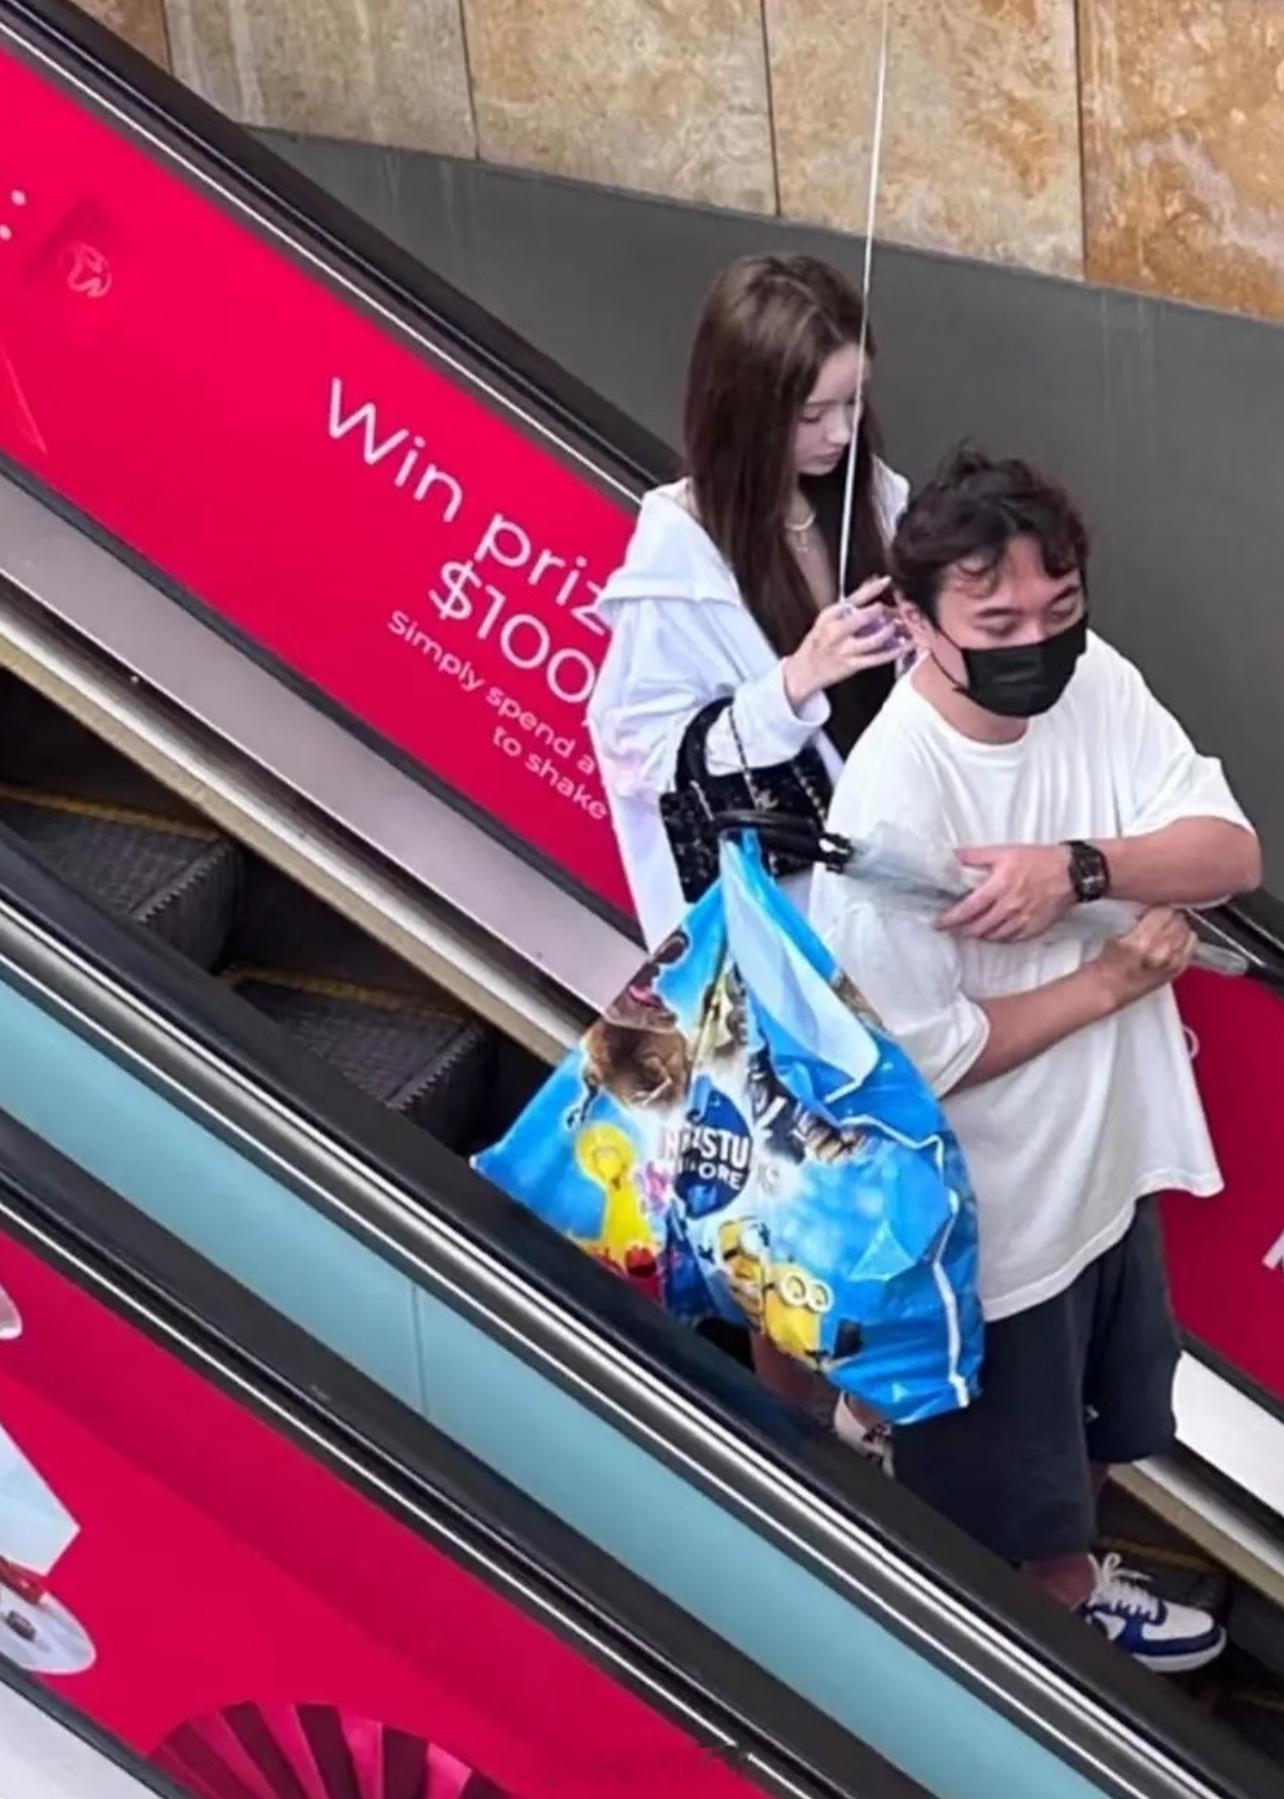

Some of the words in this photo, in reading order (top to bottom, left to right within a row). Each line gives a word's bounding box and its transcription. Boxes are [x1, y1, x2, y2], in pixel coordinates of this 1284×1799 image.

[329, 377, 464, 523] Win
[387, 610, 485, 692] Simply
[485, 686, 577, 759] spend
[492, 725, 523, 757] to
[525, 753, 608, 820] shake
